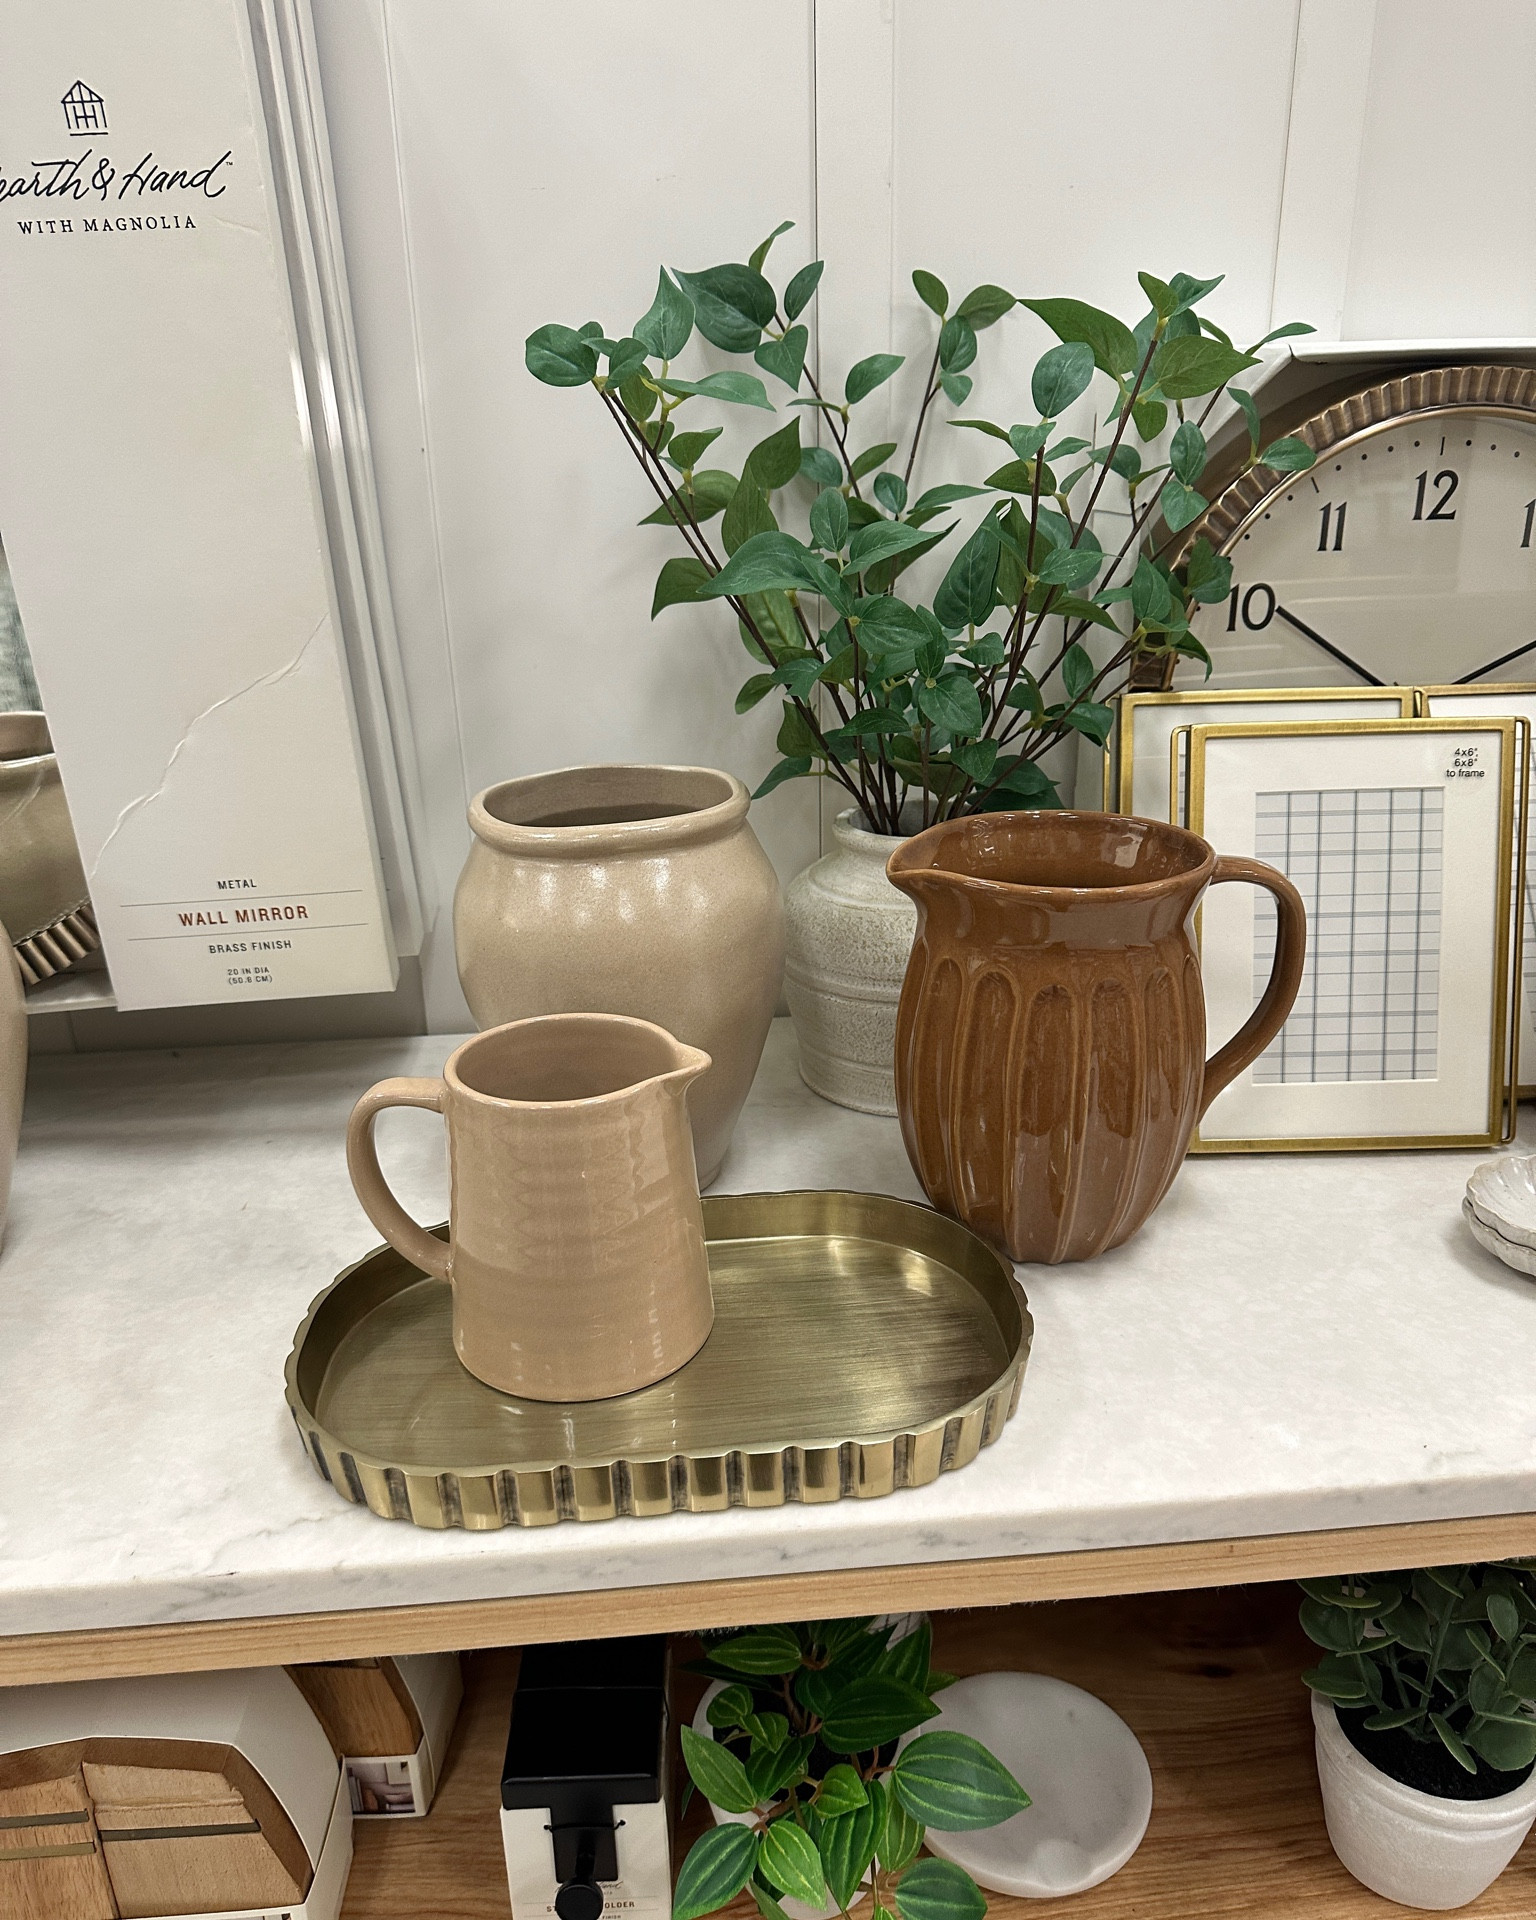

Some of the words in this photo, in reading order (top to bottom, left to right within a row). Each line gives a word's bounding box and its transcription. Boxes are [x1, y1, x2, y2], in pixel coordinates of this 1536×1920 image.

[0, 149, 92, 202] earth
[92, 158, 116, 201] &
[17, 219, 74, 235] WITH
[84, 215, 197, 232] MAGNOLIA
[1412, 469, 1459, 521] 12
[1317, 501, 1348, 552] 11
[1520, 498, 1536, 548] 1
[1226, 582, 1276, 632] 10
[1446, 769, 1456, 777] to
[1458, 768, 1485, 777] frame
[217, 879, 257, 890] METAL
[179, 911, 229, 926] WALL
[235, 905, 309, 923] MIRROR
[209, 943, 248, 954] BRASS
[252, 940, 292, 951] FINISH
[227, 968, 239, 976] 20
[228, 976, 253, 985] (50.8
[255, 975, 273, 983] CM)
[604, 1901, 635, 1909] OLDER
